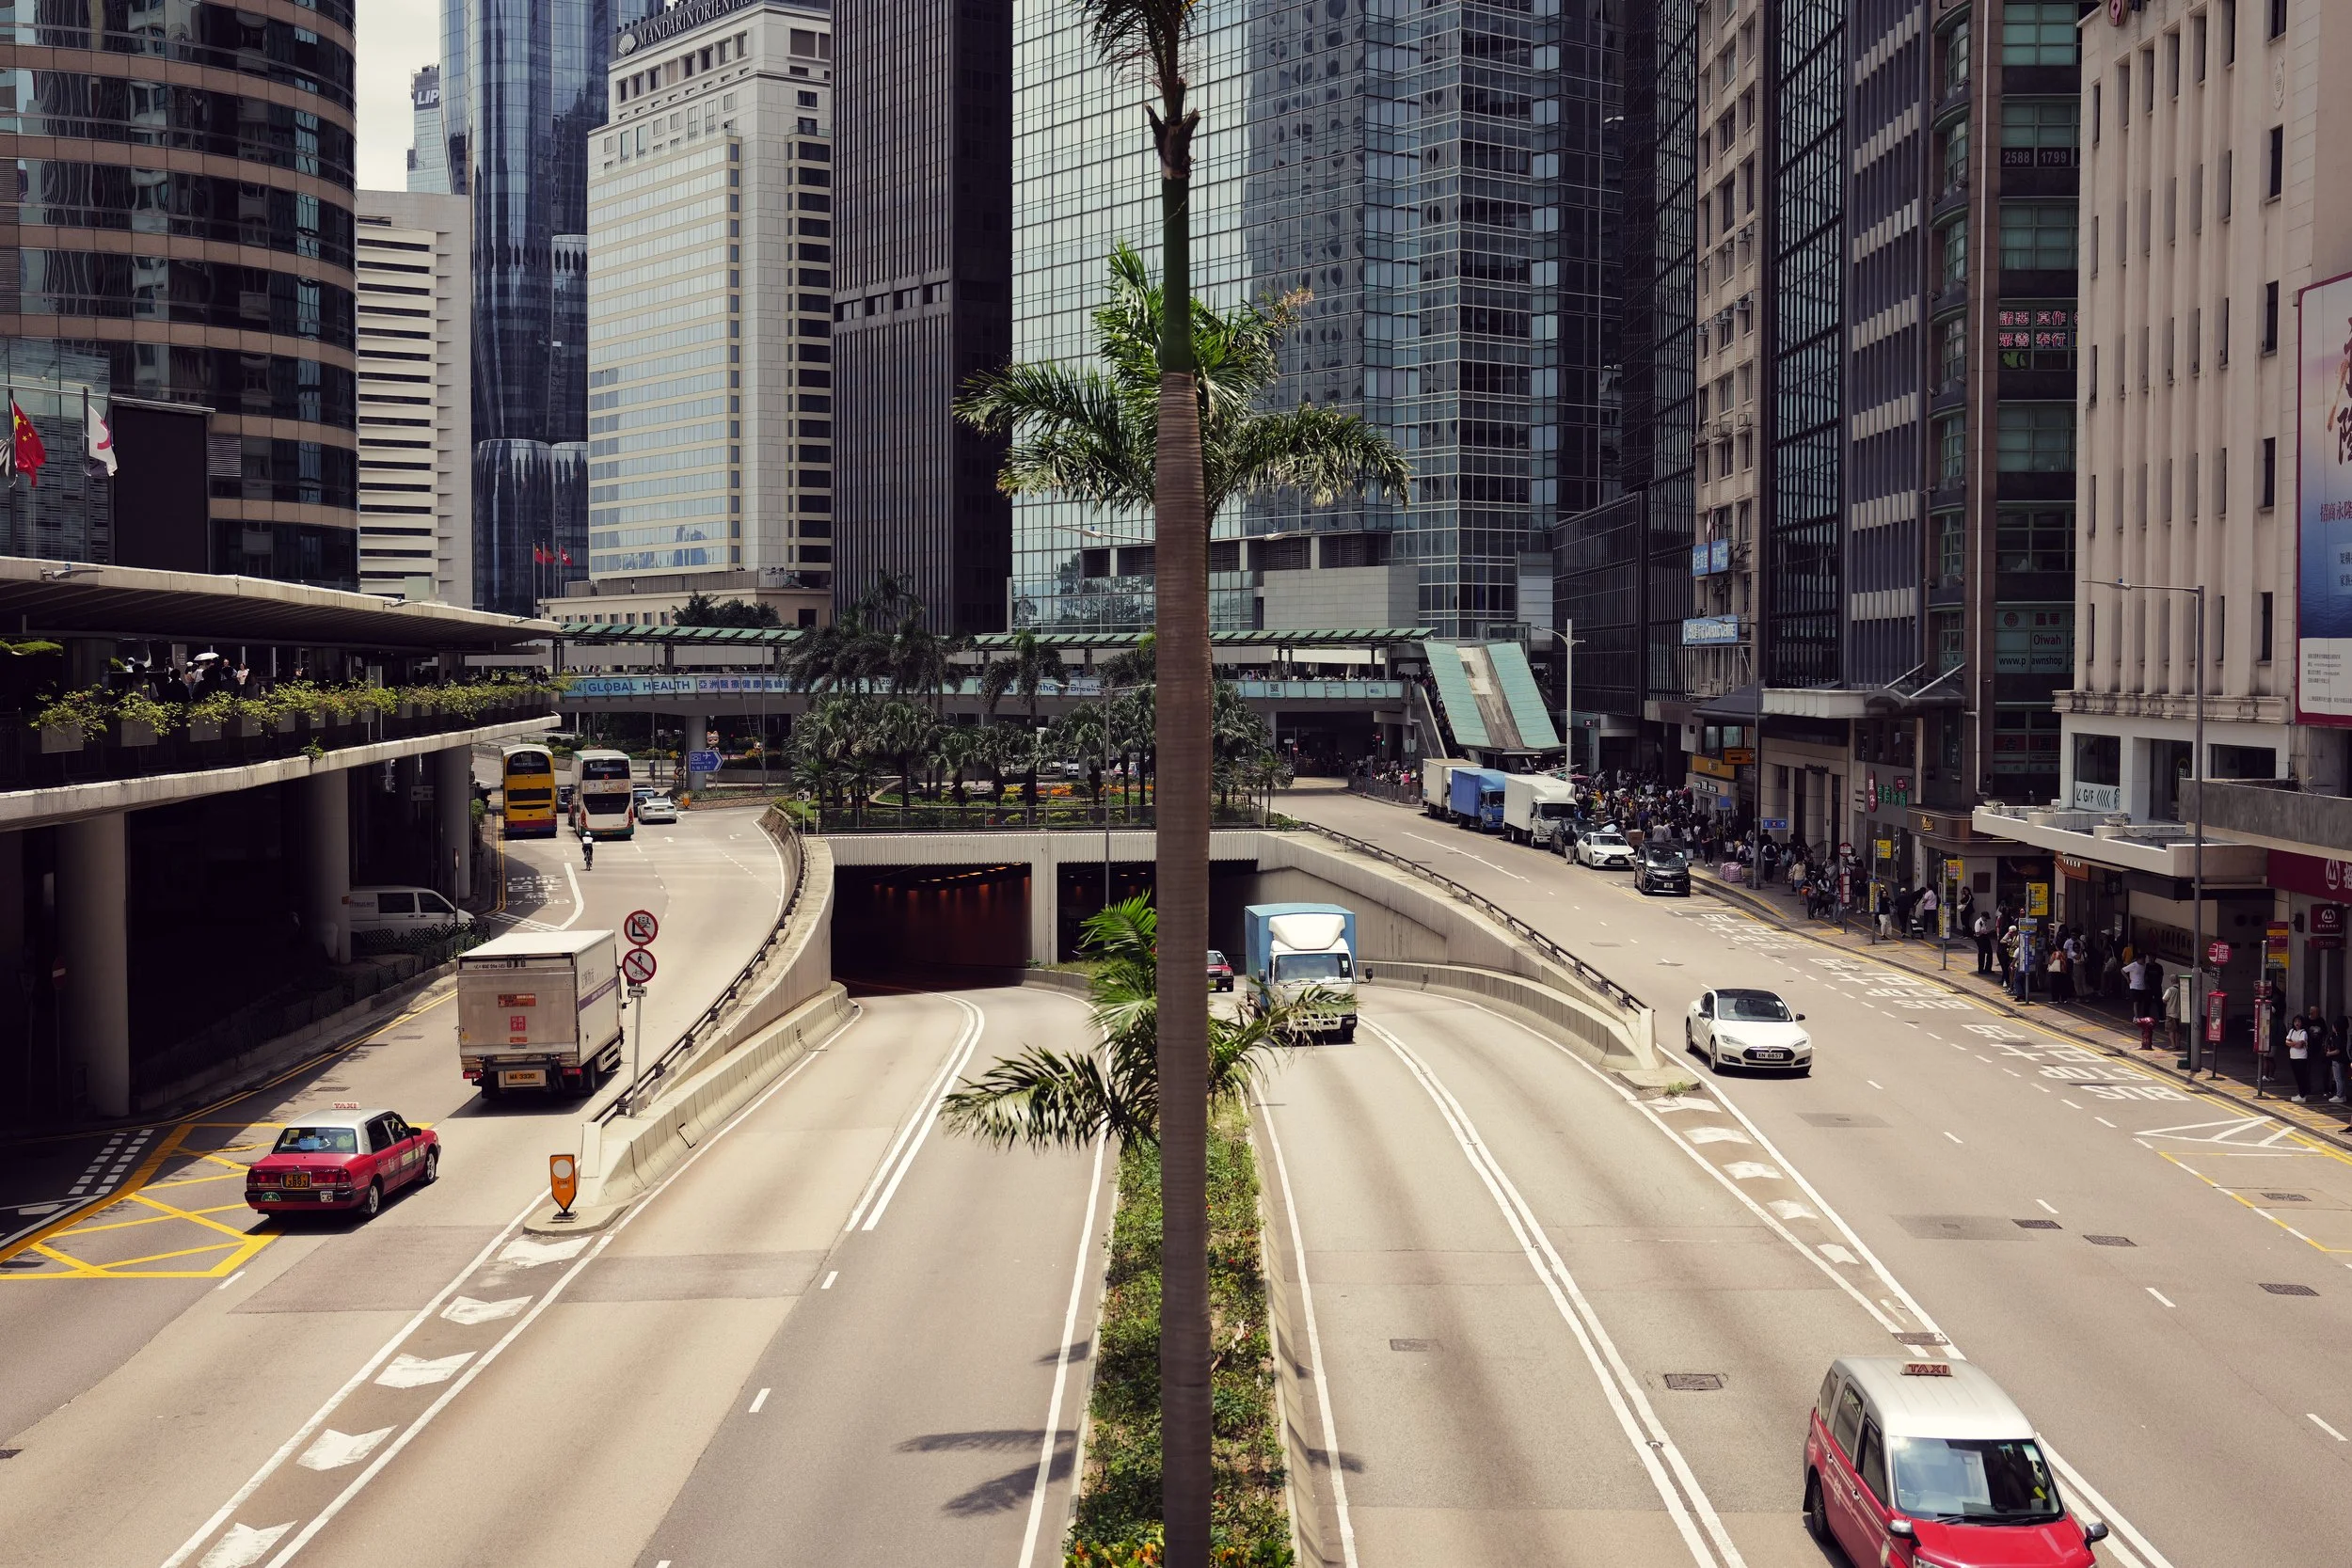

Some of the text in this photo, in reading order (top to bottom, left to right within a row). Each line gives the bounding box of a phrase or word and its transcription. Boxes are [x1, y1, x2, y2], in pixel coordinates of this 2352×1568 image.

[640, 0, 751, 47] MANDARIN ORIENT
[2005, 151, 2067, 164] 2588 1799
[2036, 310, 2067, 325] 莫作
[2036, 332, 2066, 347] 奉行
[588, 682, 637, 692] GLOBAL
[643, 680, 691, 690] HEALTH
[1893, 1000, 1974, 1009] BUS
[2081, 1085, 2190, 1101] BUS
[1909, 1363, 1947, 1373] TAXI
